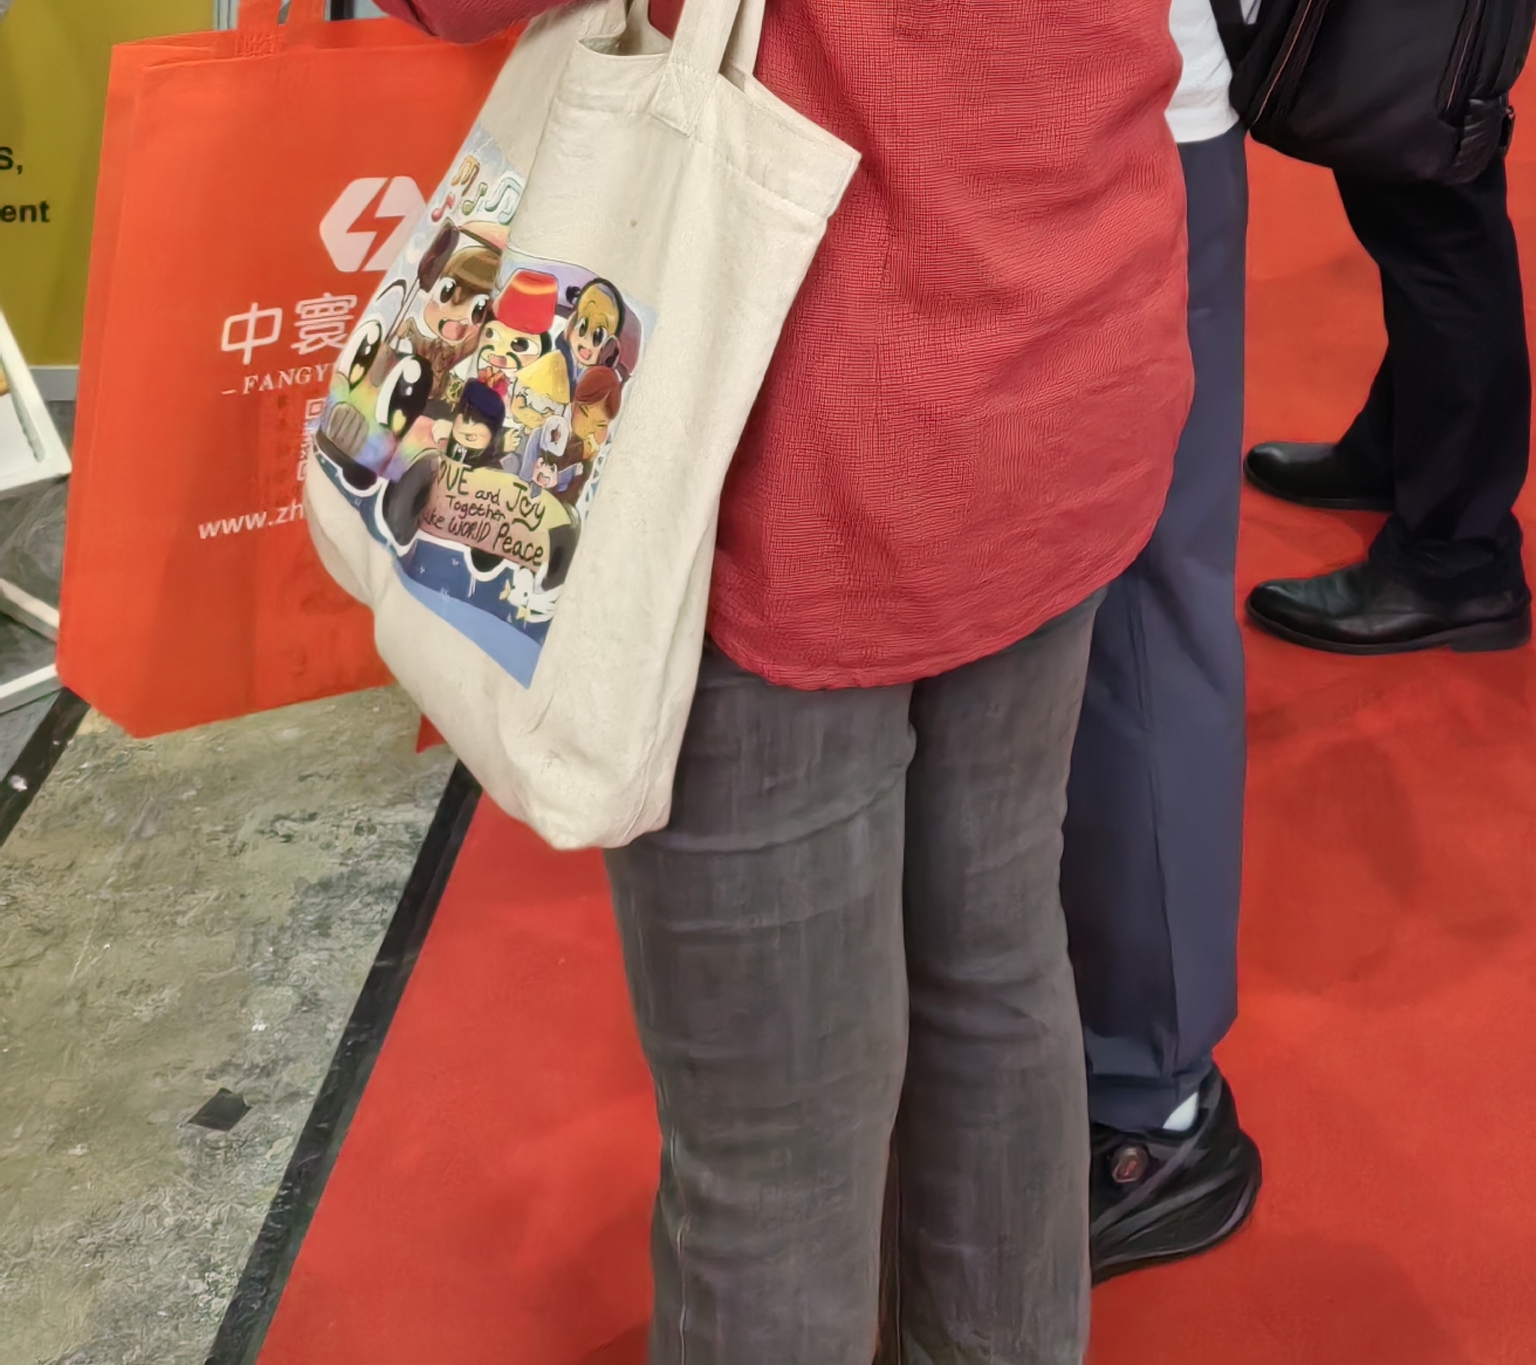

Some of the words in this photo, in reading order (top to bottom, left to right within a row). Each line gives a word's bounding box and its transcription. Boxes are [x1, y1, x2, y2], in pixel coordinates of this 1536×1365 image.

[446, 494, 506, 522] Together
[474, 488, 501, 507] and
[506, 482, 546, 532] Joy
[493, 522, 544, 568] Peace
